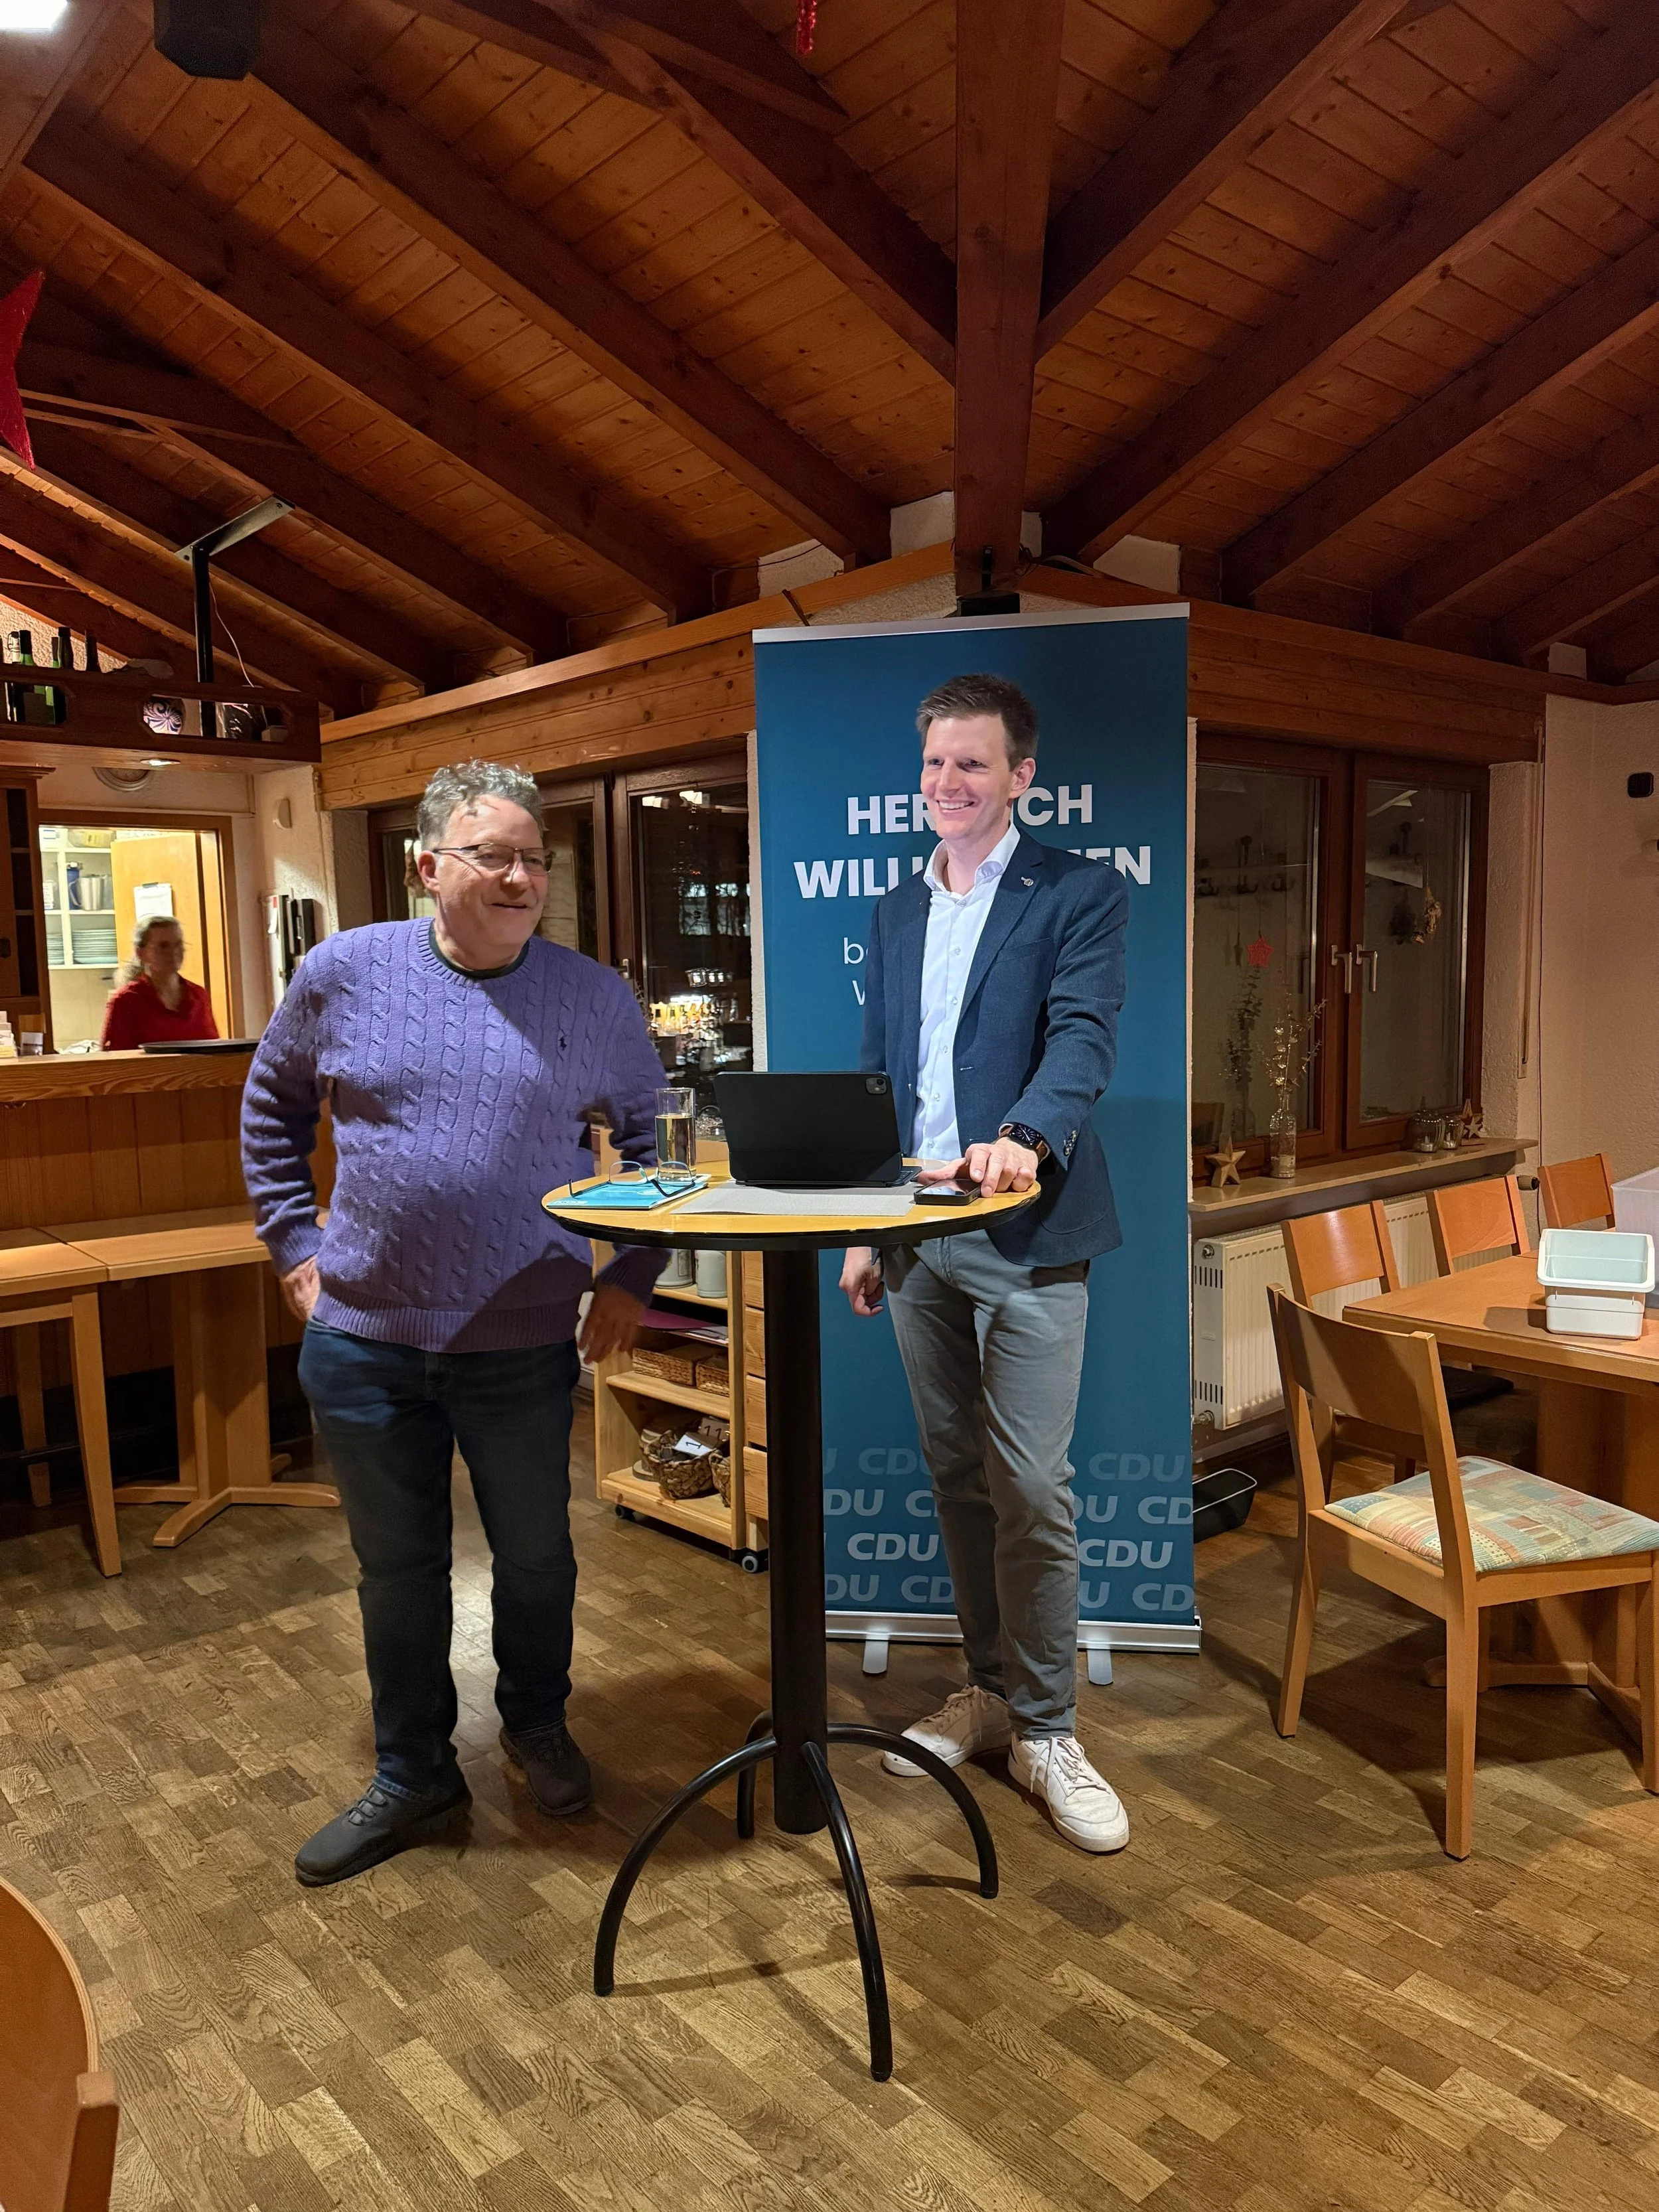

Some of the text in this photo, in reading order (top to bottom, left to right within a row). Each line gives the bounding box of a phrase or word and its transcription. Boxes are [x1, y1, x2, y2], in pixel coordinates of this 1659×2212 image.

[847, 784, 1092, 835] HERCH
[1088, 1452, 1186, 1483] CDU
[823, 1488, 885, 1516] DU
[847, 1532, 1173, 1570] CDU CDU
[825, 1574, 880, 1602] DU
[901, 1575, 956, 1603] CD
